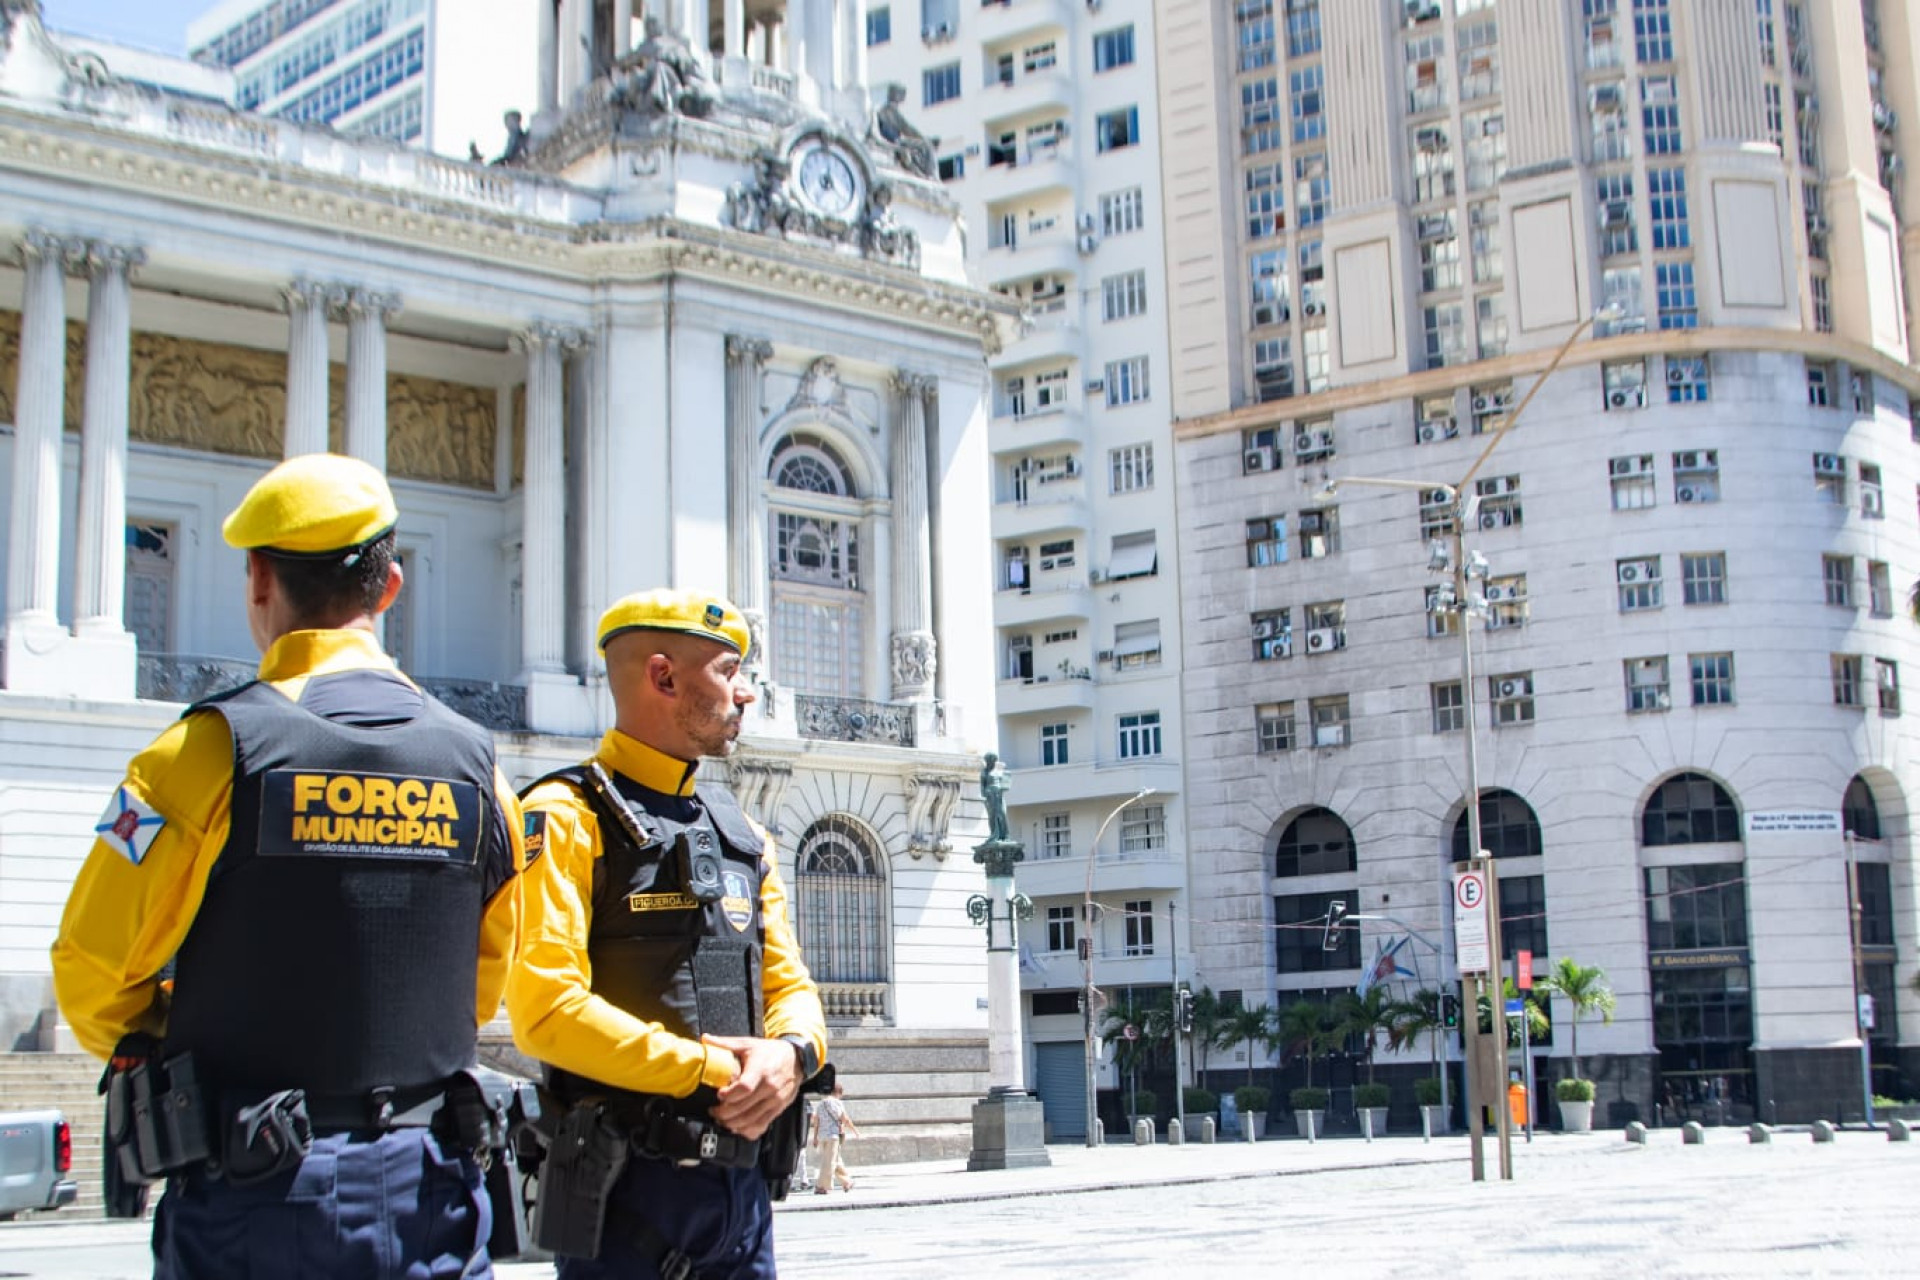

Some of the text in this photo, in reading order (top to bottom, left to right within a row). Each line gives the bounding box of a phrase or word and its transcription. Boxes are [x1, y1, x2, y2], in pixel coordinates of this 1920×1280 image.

[293, 775, 459, 820] FORÇA
[292, 816, 459, 847] MUNICIPAL
[1466, 882, 1475, 901] E
